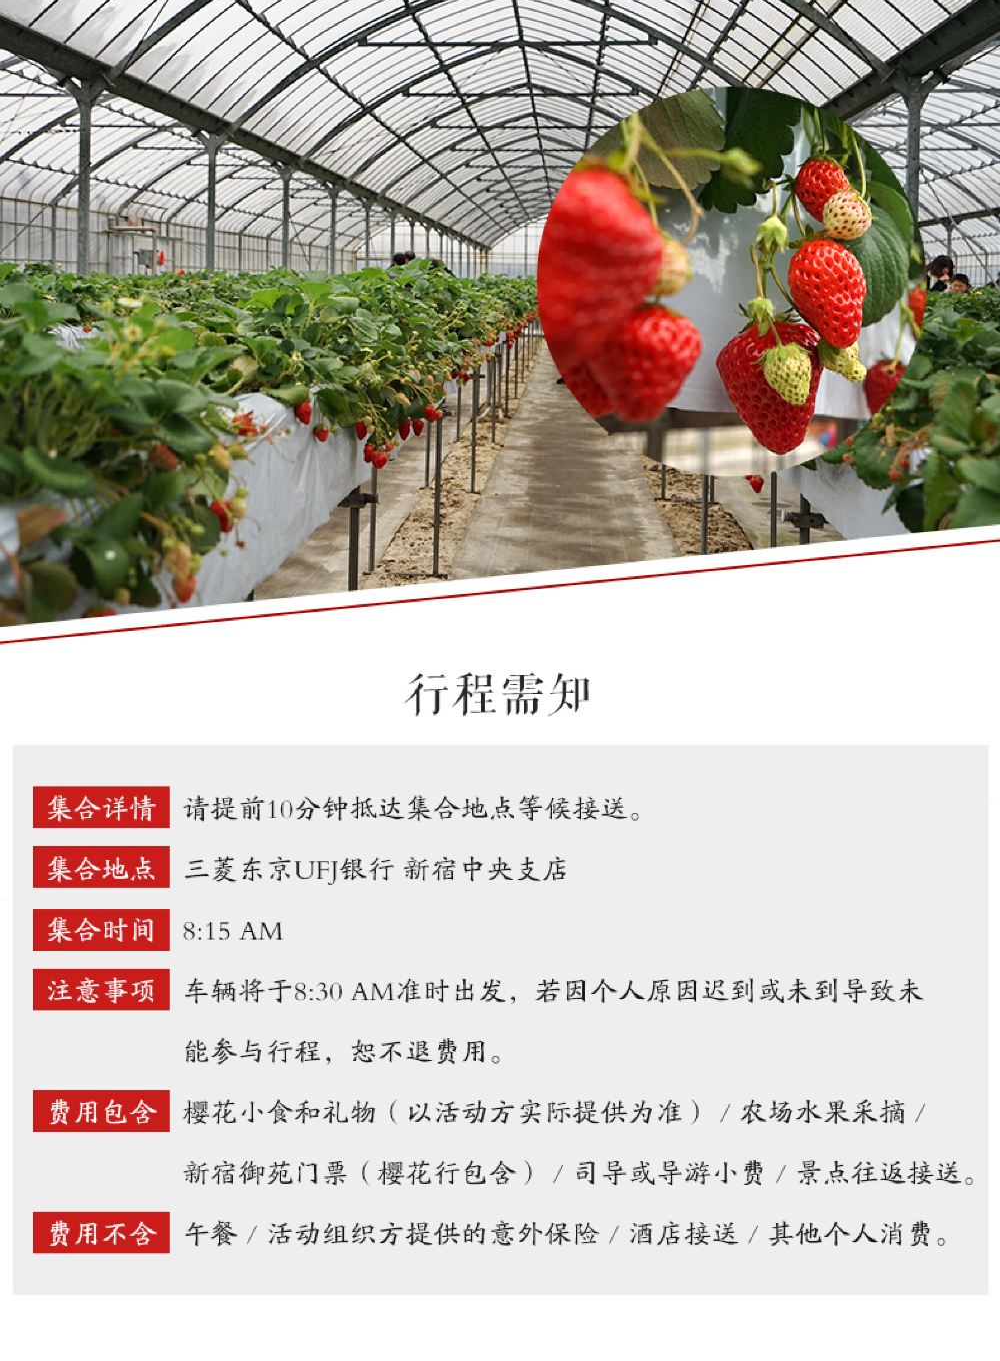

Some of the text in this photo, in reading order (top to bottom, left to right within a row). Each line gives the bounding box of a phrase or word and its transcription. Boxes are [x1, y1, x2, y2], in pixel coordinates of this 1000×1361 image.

[404, 672, 589, 716] 行程需知
[48, 795, 156, 822] 集合详情
[48, 856, 155, 883] 集合地点
[404, 856, 566, 882] 新宿中央支店
[48, 917, 153, 943] 集合时间
[183, 922, 282, 940] 8:15 AM
[48, 977, 154, 1004] 注意事项
[49, 1099, 157, 1125] 费用包含
[741, 1099, 904, 1125] 农场水果采摘
[577, 1160, 763, 1186] 司导或导游小费
[797, 1160, 973, 1185] 景点往返接送。
[50, 1220, 157, 1247] 费用不含
[185, 1220, 238, 1246] 午餐
[630, 1221, 739, 1245] 酒店接送
[769, 1220, 945, 1246] 其他个人消费。
